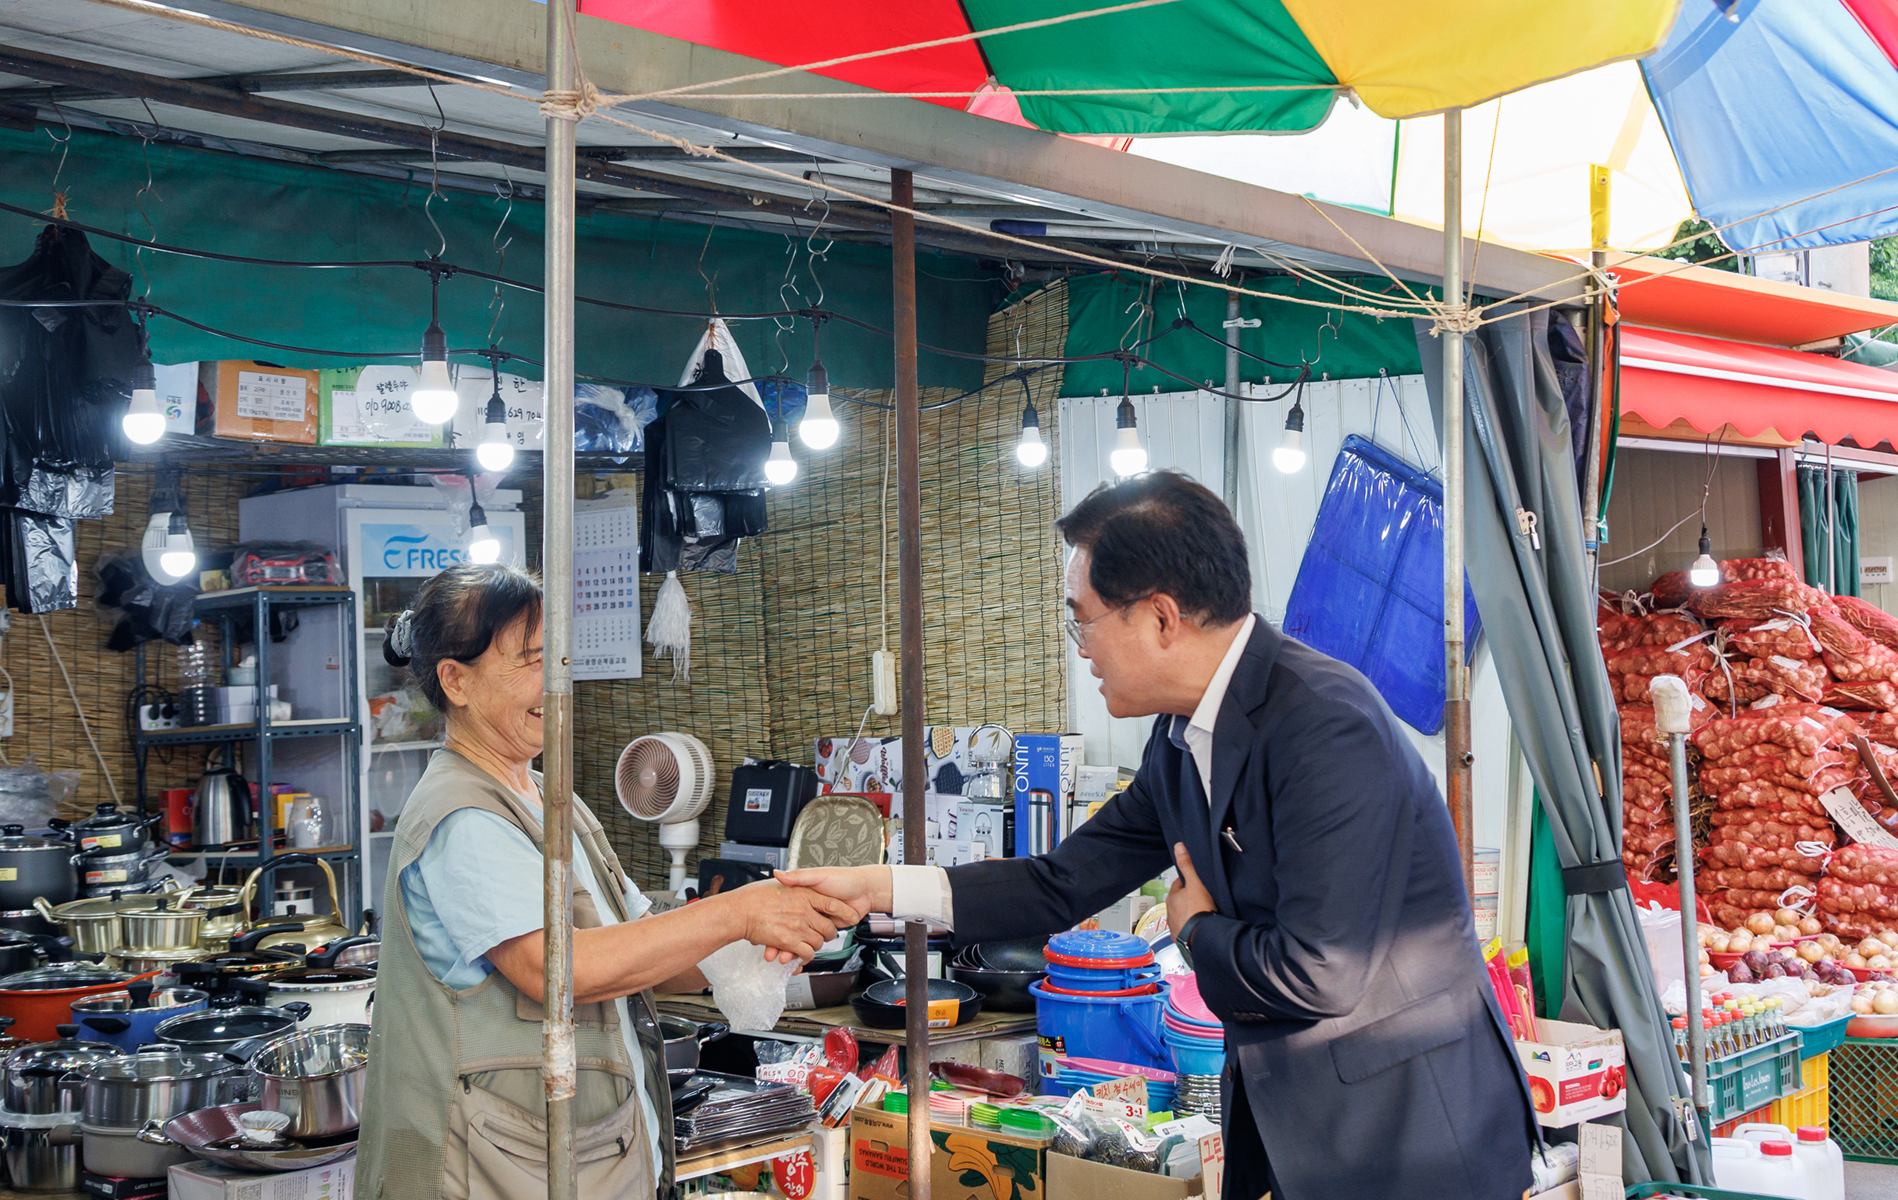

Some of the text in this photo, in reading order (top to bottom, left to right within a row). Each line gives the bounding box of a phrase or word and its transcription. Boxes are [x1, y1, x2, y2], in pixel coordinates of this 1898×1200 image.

[408, 549, 469, 569] FRES
[1016, 740, 1029, 792] JUNO
[1060, 742, 1070, 794] JUNO
[1126, 1105, 1142, 1117] 3+1
[859, 1148, 883, 1159] BANANAS
[865, 1160, 884, 1170] WORLD
[886, 1164, 896, 1172] THE
